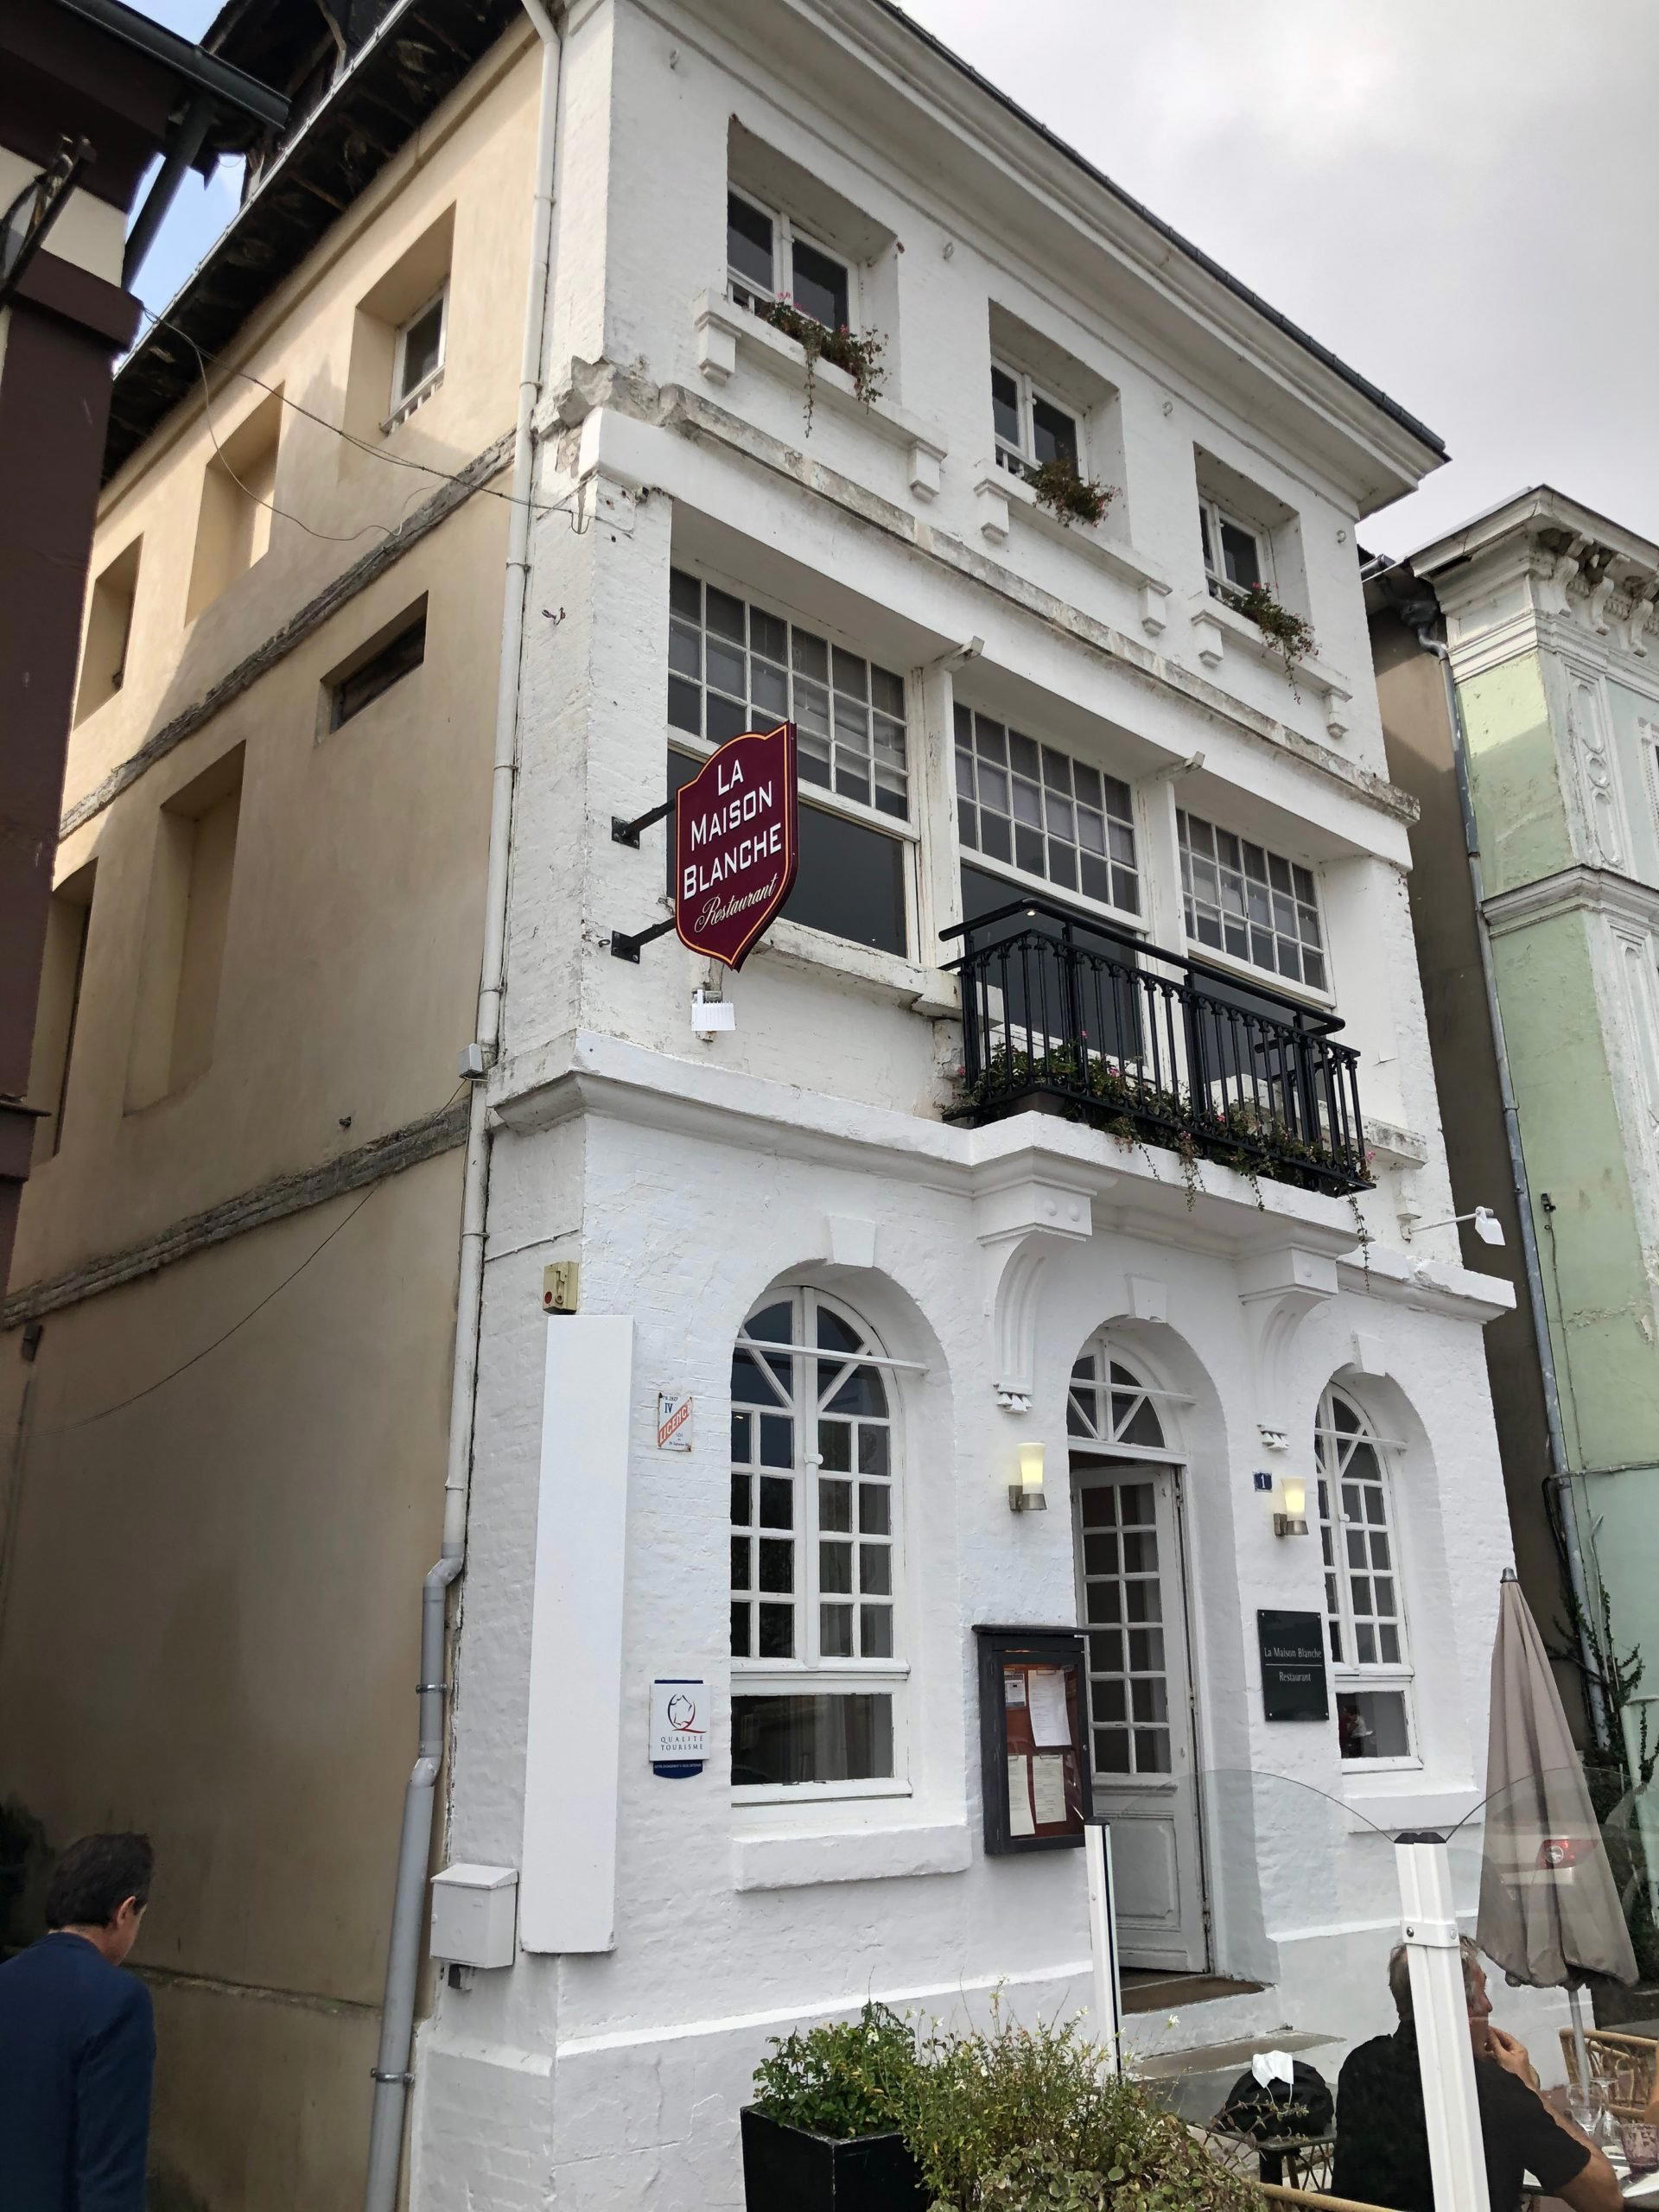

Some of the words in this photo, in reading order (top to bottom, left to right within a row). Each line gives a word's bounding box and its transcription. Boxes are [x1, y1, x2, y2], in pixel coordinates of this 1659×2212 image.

[717, 759, 744, 797] LA
[690, 780, 773, 852] MAISON
[683, 822, 783, 900] BLANCHE
[694, 873, 779, 933] Restaurant
[664, 1402, 673, 1414] IV
[1261, 1474, 1266, 1489] 1
[1264, 1647, 1272, 1657] La
[1274, 1647, 1296, 1658] Maison
[1298, 1648, 1322, 1659] Blanche
[1279, 1671, 1312, 1682] Restaurant
